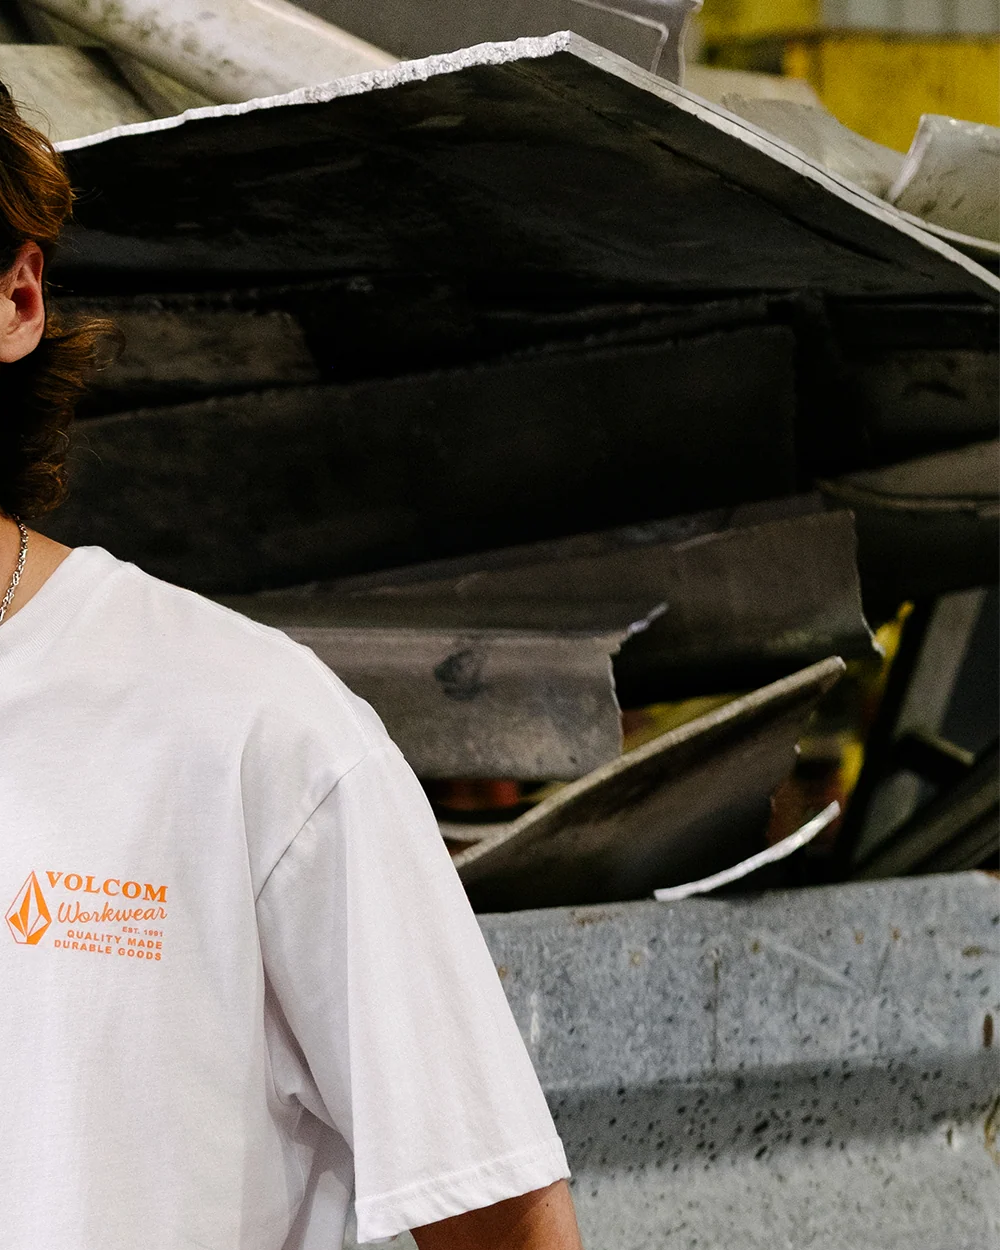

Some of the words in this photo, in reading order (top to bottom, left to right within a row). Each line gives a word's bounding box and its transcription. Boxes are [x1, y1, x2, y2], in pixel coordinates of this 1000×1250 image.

[46, 870, 168, 903] VOLCOM
[57, 901, 167, 923] Workwear
[67, 929, 122, 944] QUALITY
[127, 937, 163, 950] MADE
[122, 926, 140, 934] EST.
[143, 929, 164, 937] 1991
[54, 939, 112, 955] DURABLE
[117, 949, 162, 961] GOODS
